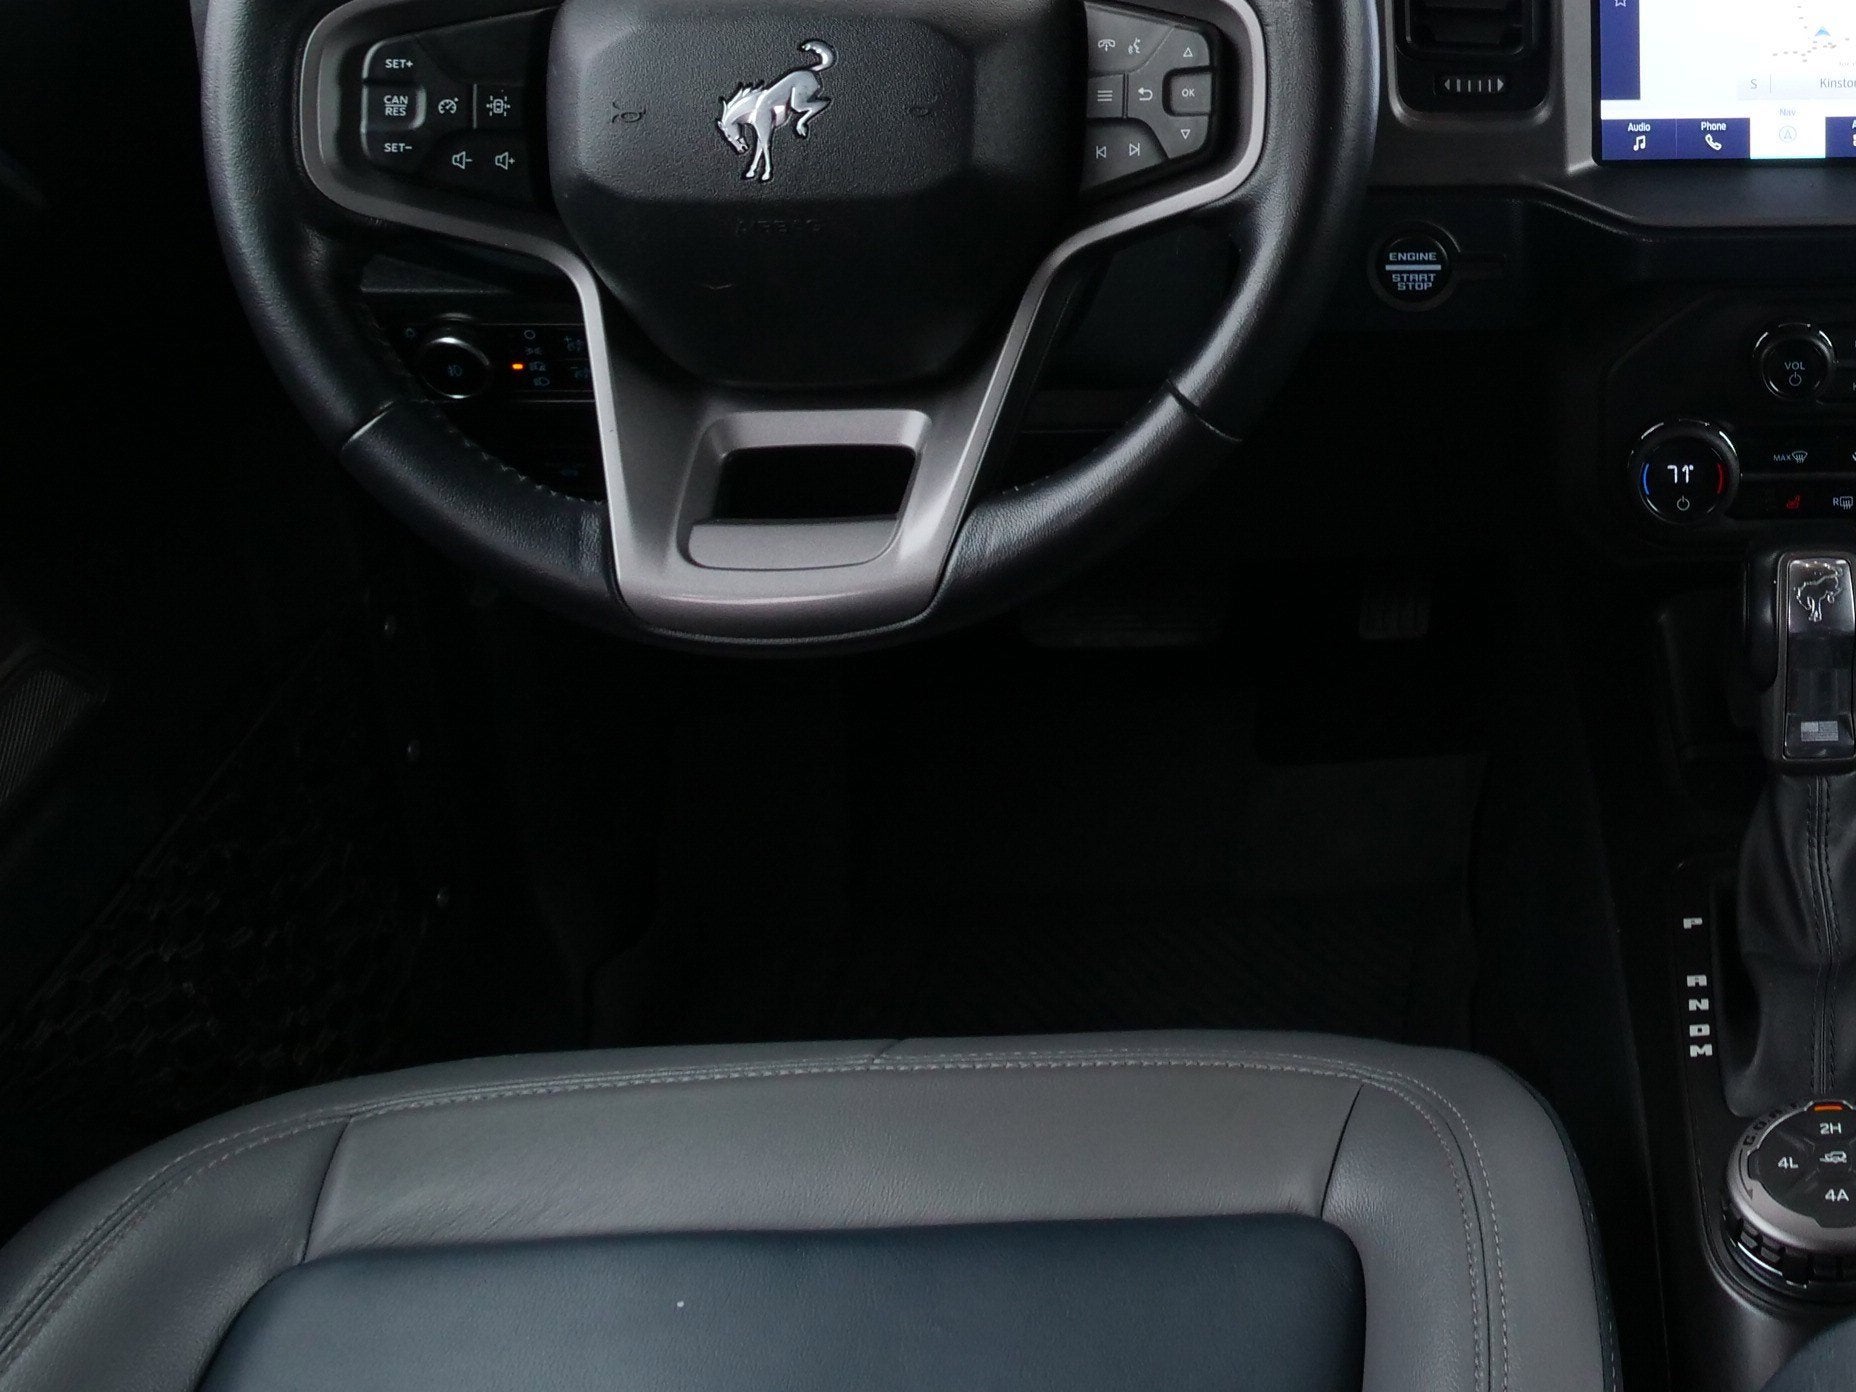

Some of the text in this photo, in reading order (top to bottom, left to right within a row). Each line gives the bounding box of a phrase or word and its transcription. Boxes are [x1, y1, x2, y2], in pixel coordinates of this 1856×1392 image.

[385, 59, 414, 69] SET+
[1750, 78, 1758, 90] S
[1181, 88, 1196, 98] OK
[383, 95, 409, 105] CAN
[384, 108, 407, 117] RES
[1779, 107, 1796, 117] Nav
[1627, 121, 1651, 132] Audio
[1701, 121, 1727, 132] Phone
[1389, 252, 1437, 261] ENGINE
[1392, 273, 1437, 282] START
[1397, 282, 1433, 291] STOP
[1784, 361, 1806, 371] VOL
[1773, 452, 1792, 462] MAX
[1683, 918, 1703, 930] P
[1686, 974, 1708, 988] R
[1688, 998, 1710, 1012] N
[1689, 1023, 1711, 1038] D
[1689, 1043, 1713, 1058] M
[1819, 1122, 1842, 1135] 2H
[1777, 1157, 1799, 1169] 4L
[1824, 1188, 1850, 1202] 4A
